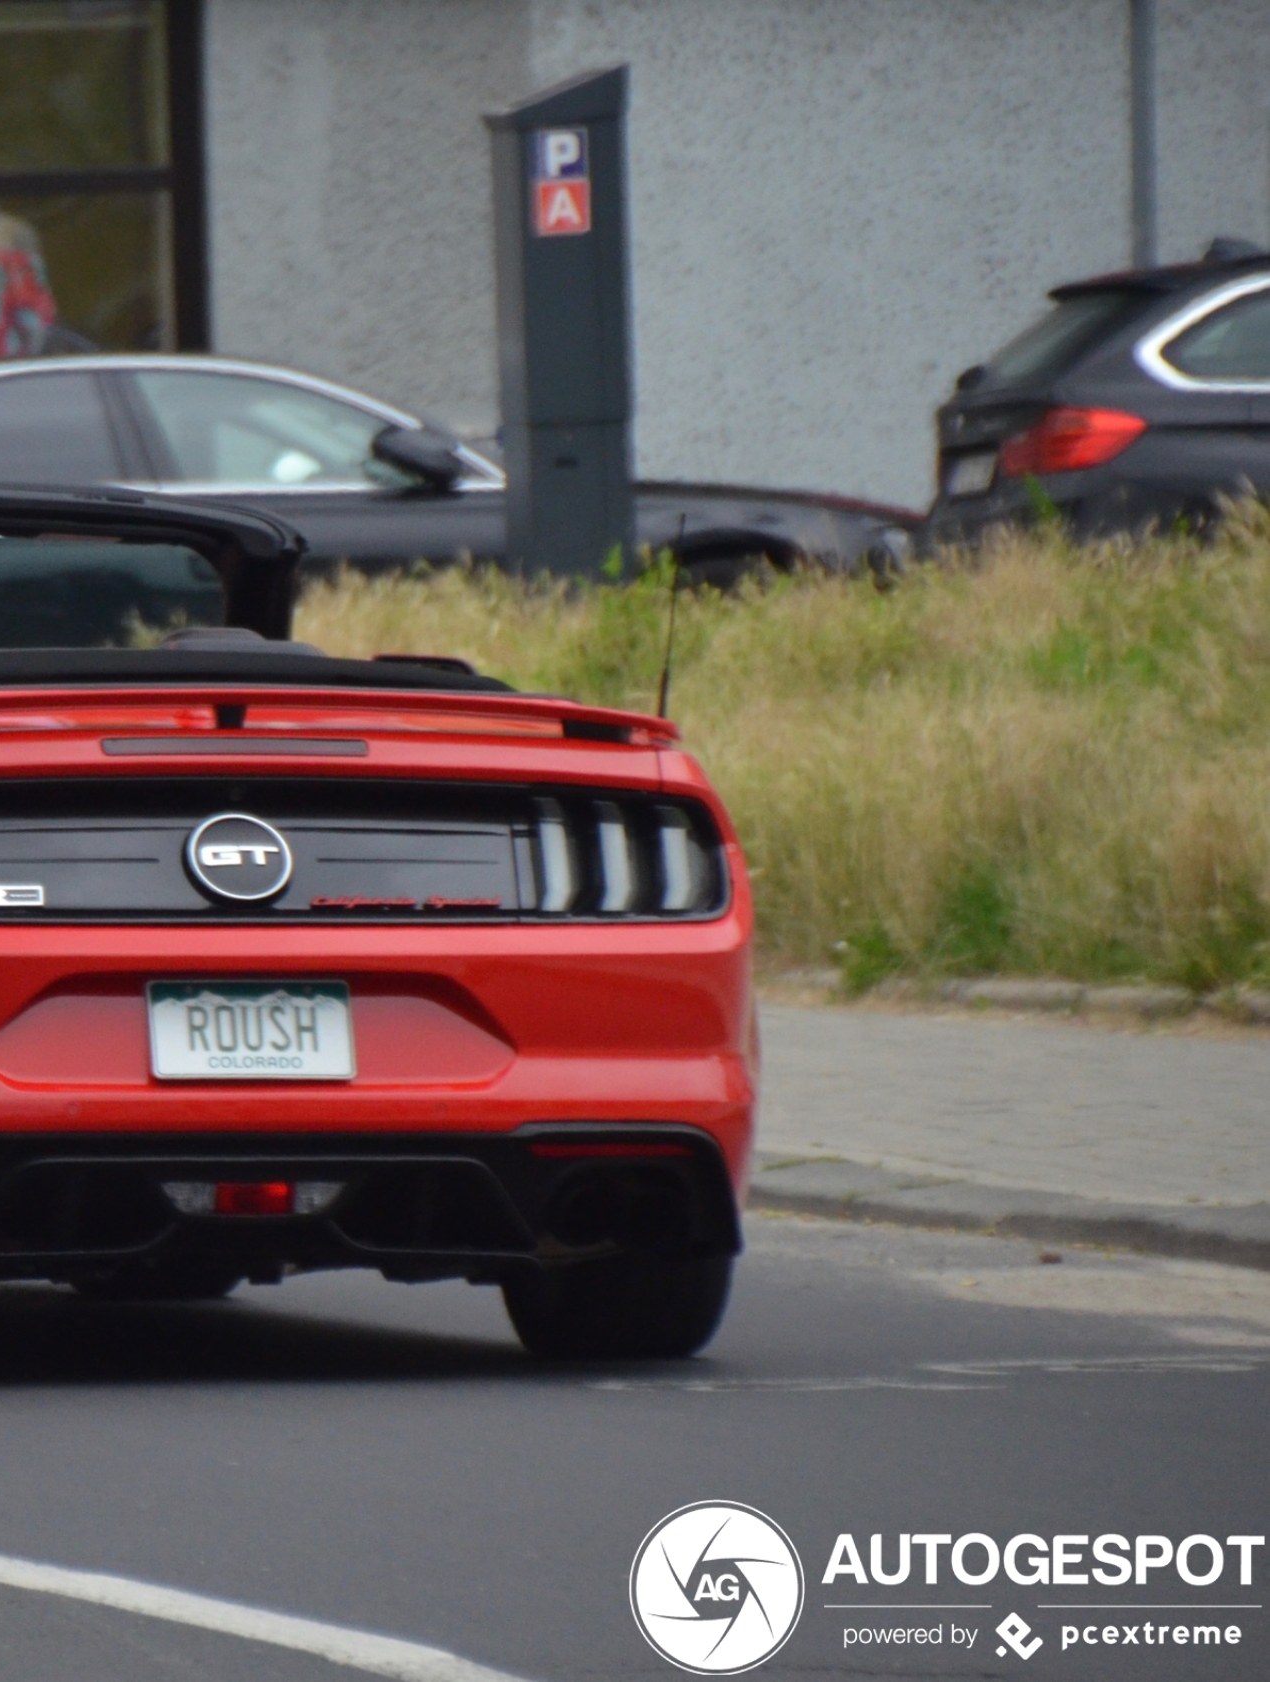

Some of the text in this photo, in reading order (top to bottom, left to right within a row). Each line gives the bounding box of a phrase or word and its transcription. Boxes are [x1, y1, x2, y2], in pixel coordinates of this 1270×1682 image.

[547, 132, 581, 176] P
[548, 187, 583, 225] A
[199, 844, 280, 867] GT
[186, 1005, 320, 1052] ROUSH
[208, 1056, 304, 1069] COLORADO
